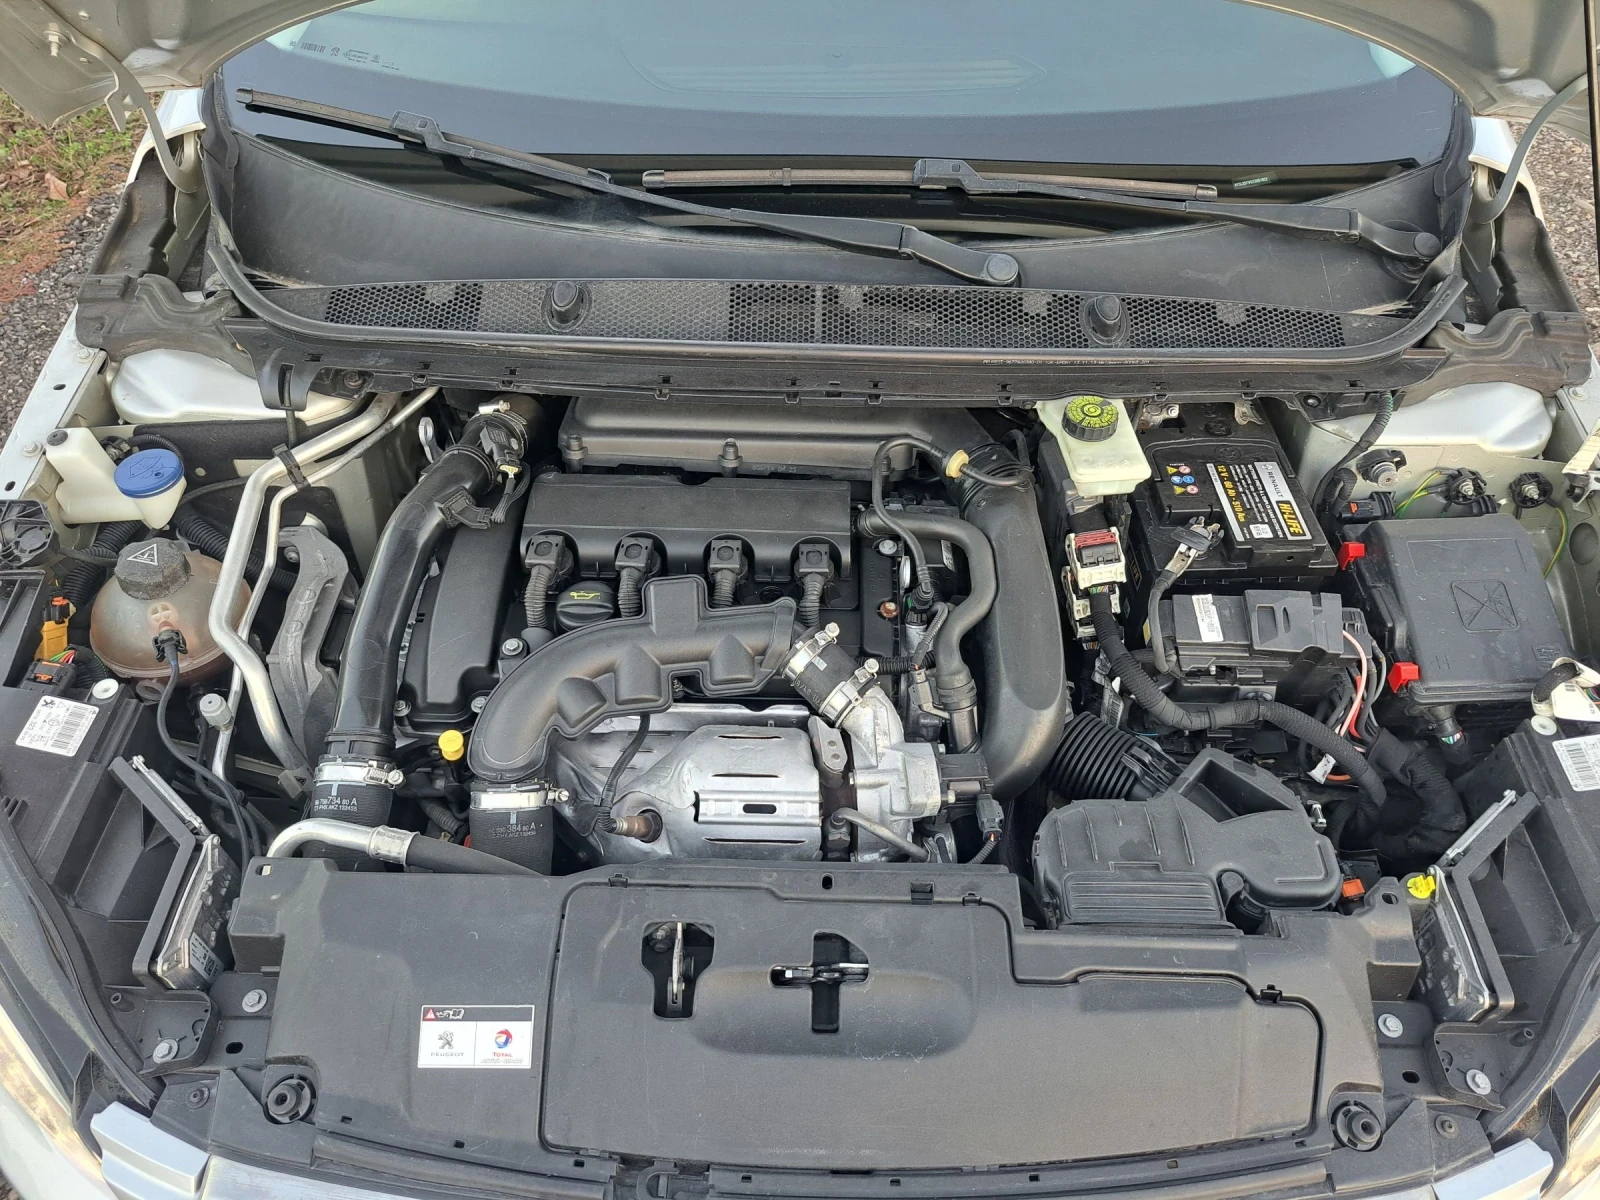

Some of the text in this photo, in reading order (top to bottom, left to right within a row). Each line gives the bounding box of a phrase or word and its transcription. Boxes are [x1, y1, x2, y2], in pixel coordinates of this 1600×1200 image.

[1267, 471, 1284, 497] RENAULT
[1232, 501, 1242, 511] 510
[328, 796, 340, 804] 734
[350, 797, 357, 805] A
[507, 824, 521, 832] 384
[530, 822, 536, 830] A
